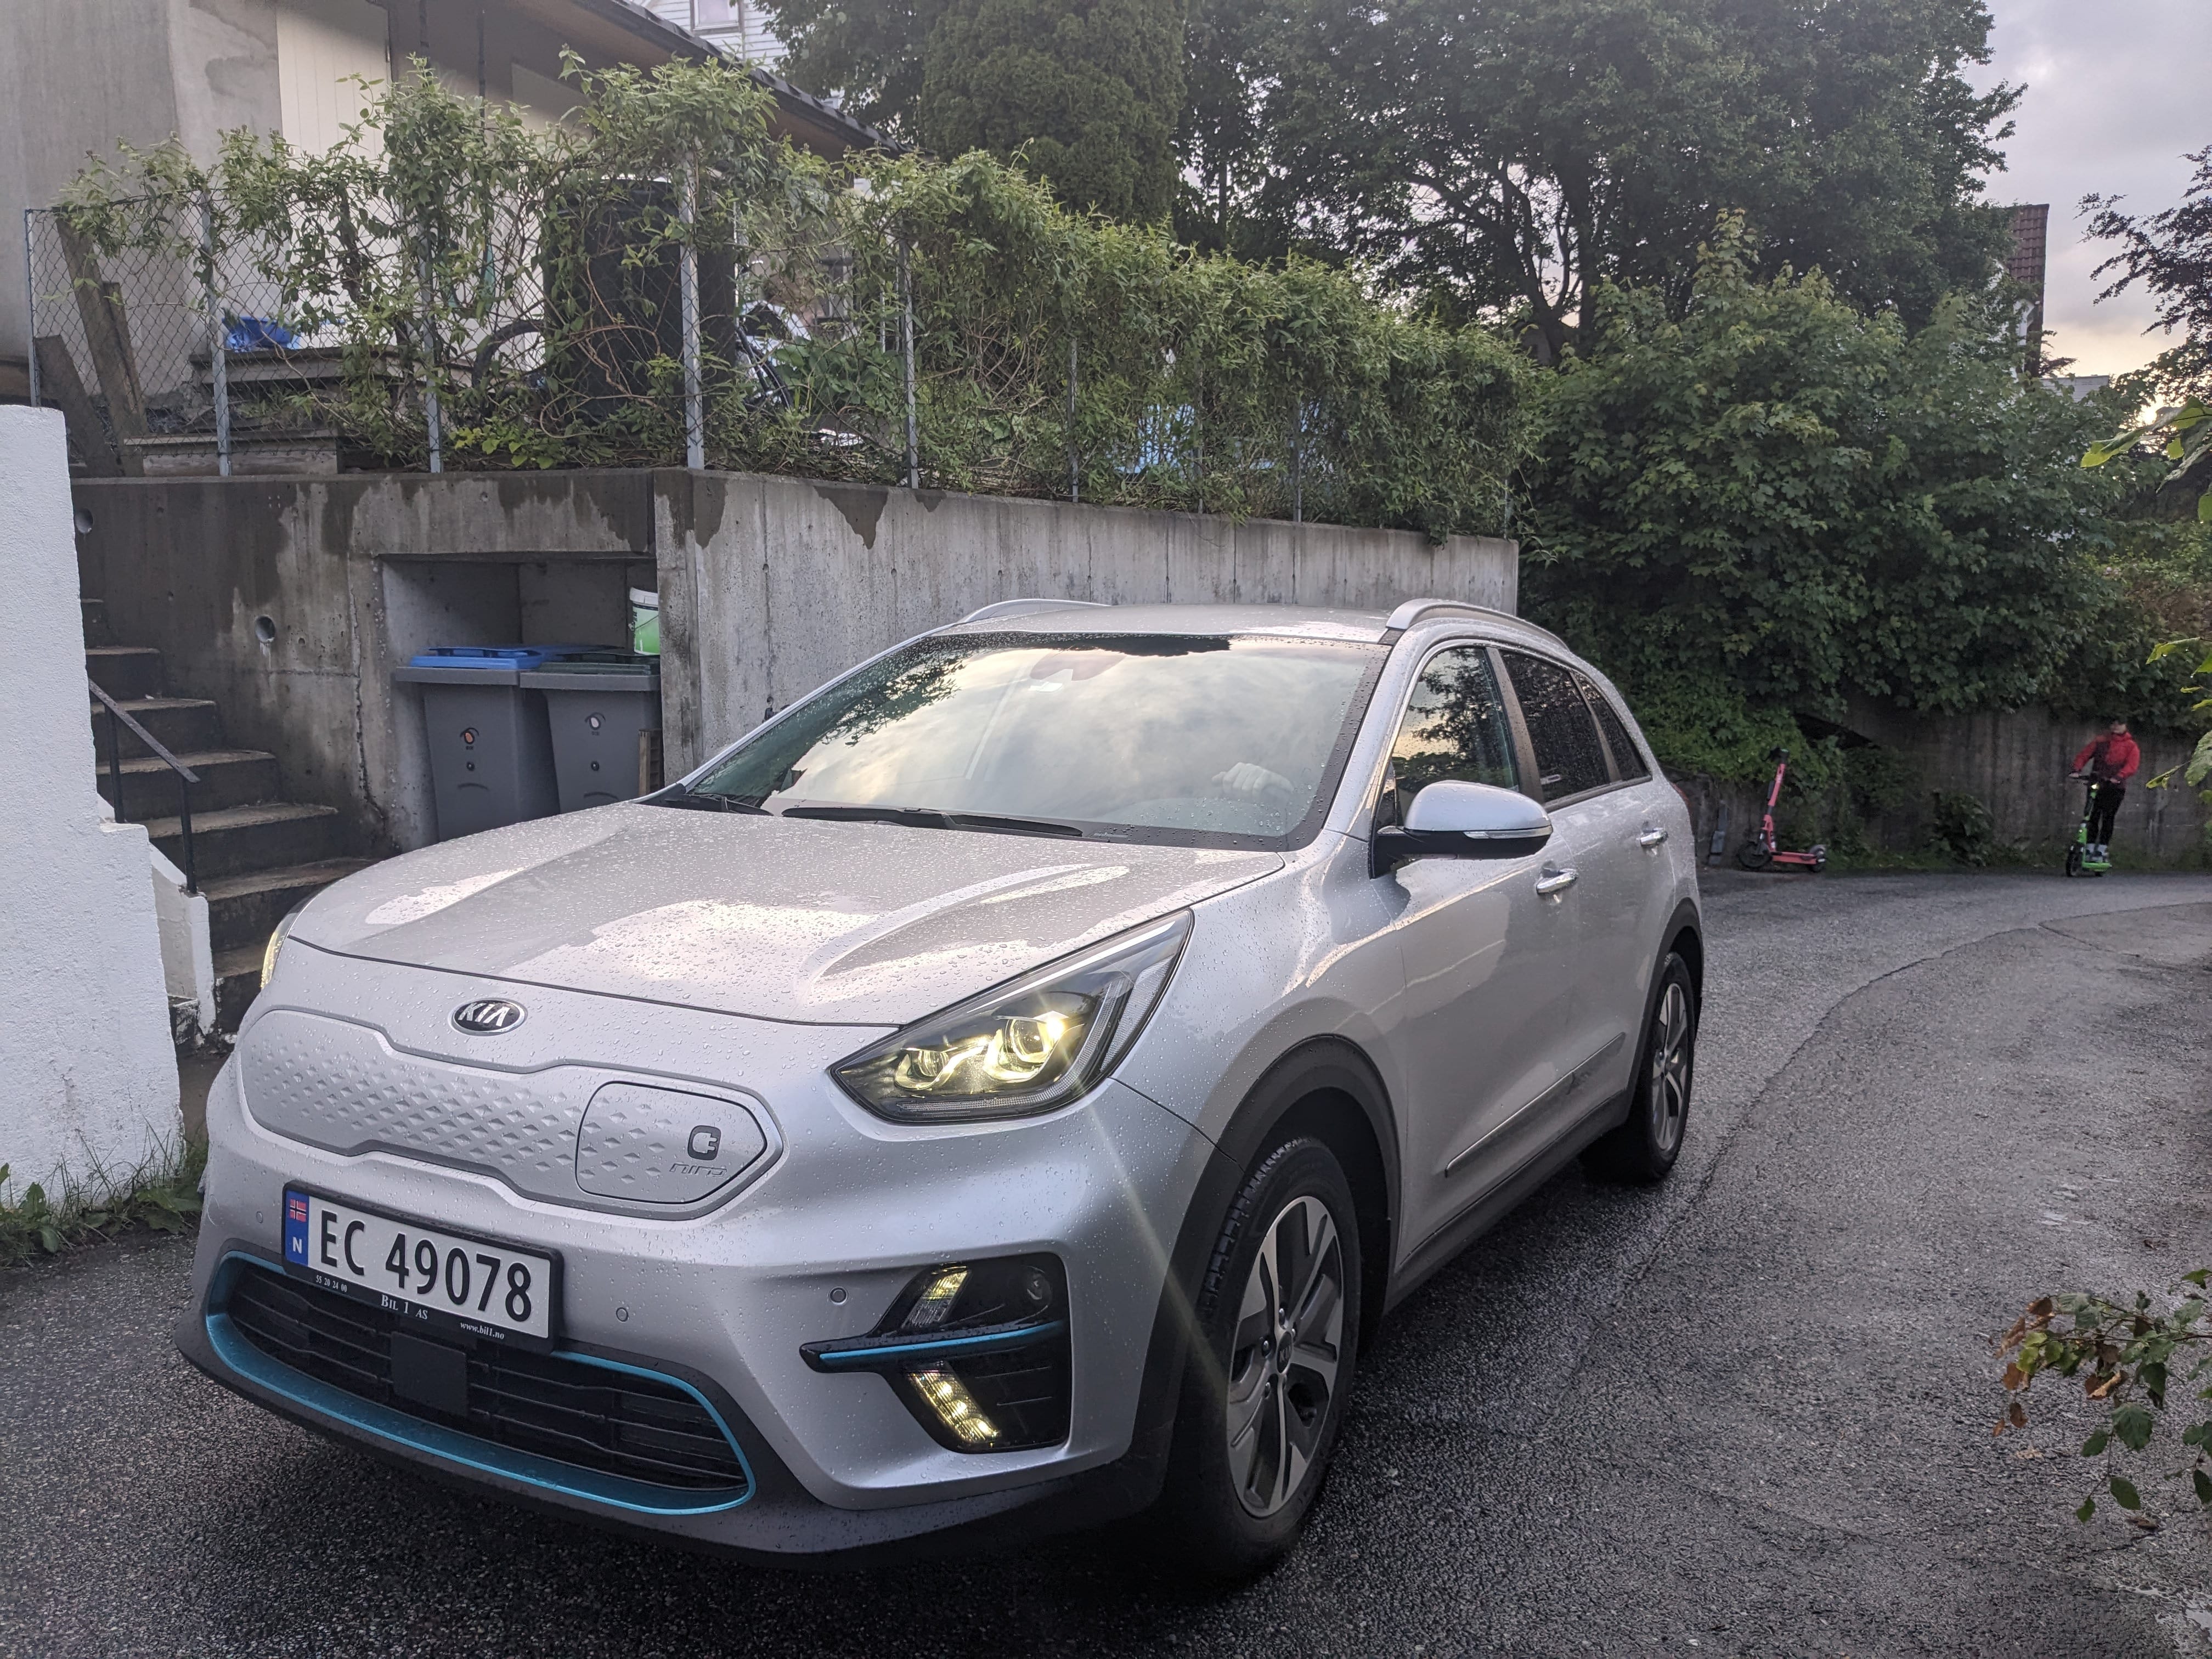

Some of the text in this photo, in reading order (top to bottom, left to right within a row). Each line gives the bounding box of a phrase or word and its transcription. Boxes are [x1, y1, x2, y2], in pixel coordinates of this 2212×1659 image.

[458, 1002, 511, 1026] KIA
[292, 1237, 303, 1254] N
[320, 1210, 532, 1322] EC 49078
[316, 1275, 347, 1293] 55 20 24 00
[403, 1301, 409, 1314] 1
[415, 1308, 428, 1320] AS
